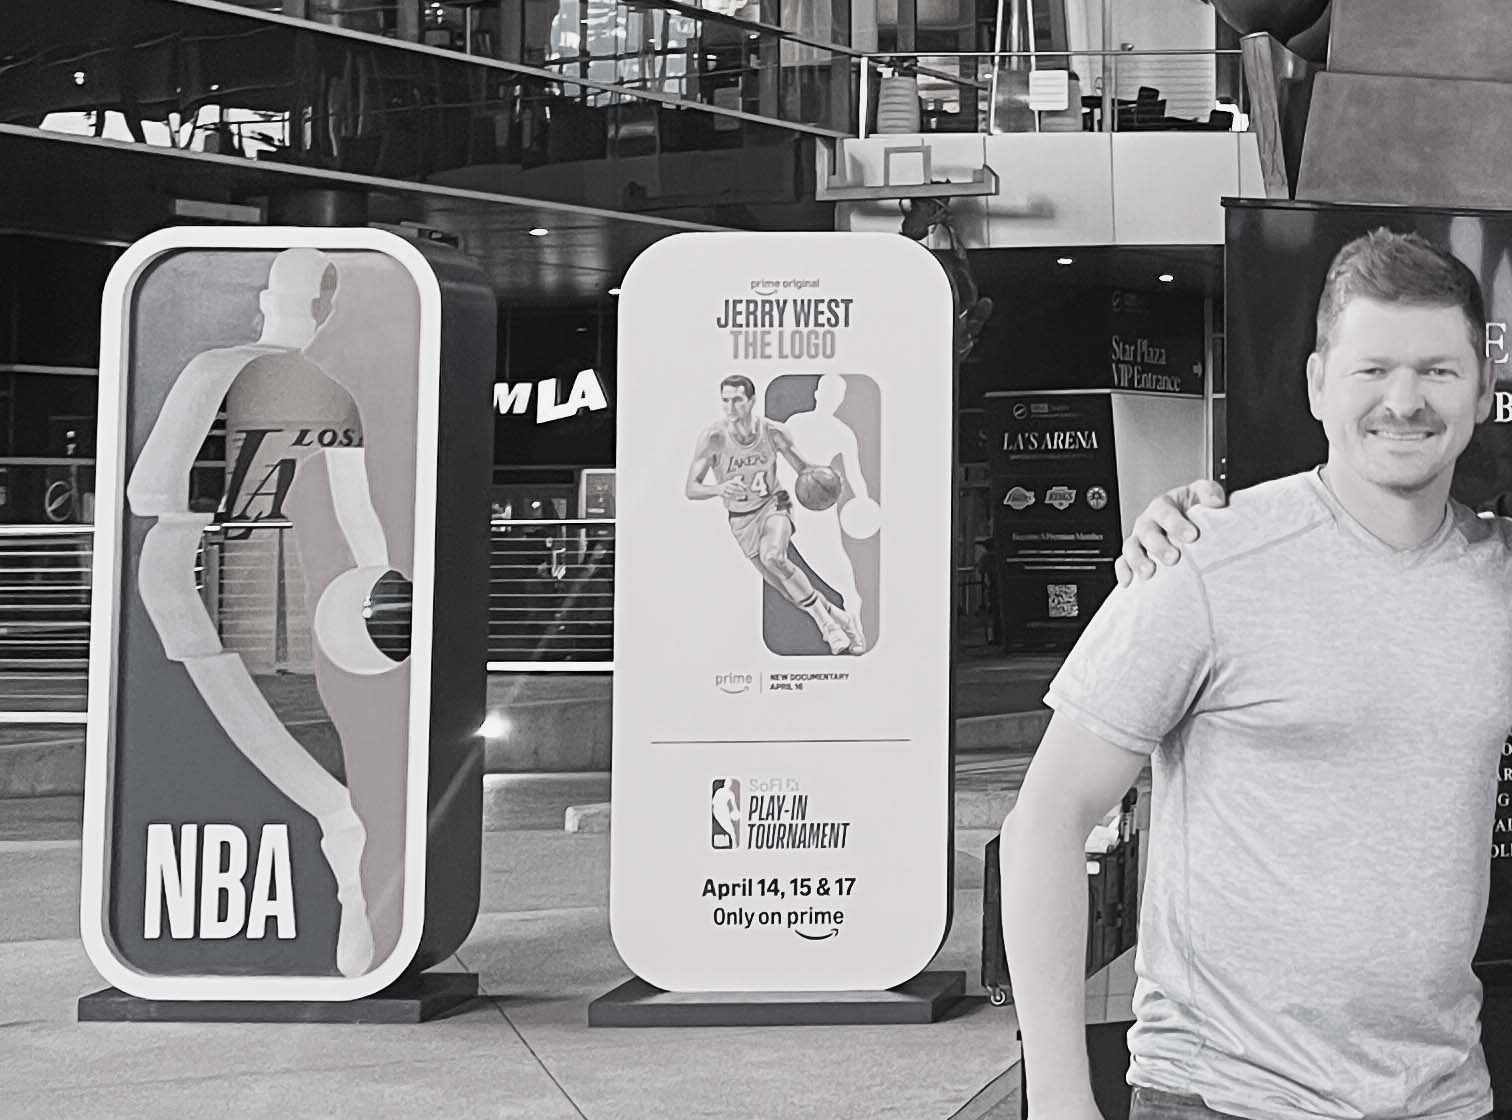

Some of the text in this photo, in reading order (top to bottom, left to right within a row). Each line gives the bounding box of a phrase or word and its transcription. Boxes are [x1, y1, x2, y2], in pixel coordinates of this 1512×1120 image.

[750, 278, 820, 290] prime original
[717, 299, 853, 328] JERRY WEST
[730, 330, 836, 359] THE LOGO
[1112, 335, 1167, 365] Star Plaza
[1111, 362, 1181, 391] VIP Entrance
[1003, 431, 1099, 450] LA'S ARENA
[715, 672, 849, 686] prime NEW DOCUMENTARY
[748, 795, 808, 821] PLAY-IN
[747, 822, 851, 850] TOURNAMENT
[143, 823, 297, 940] NBA
[702, 877, 857, 901] April 14, 15 & 17
[713, 906, 844, 929] Only on prime
